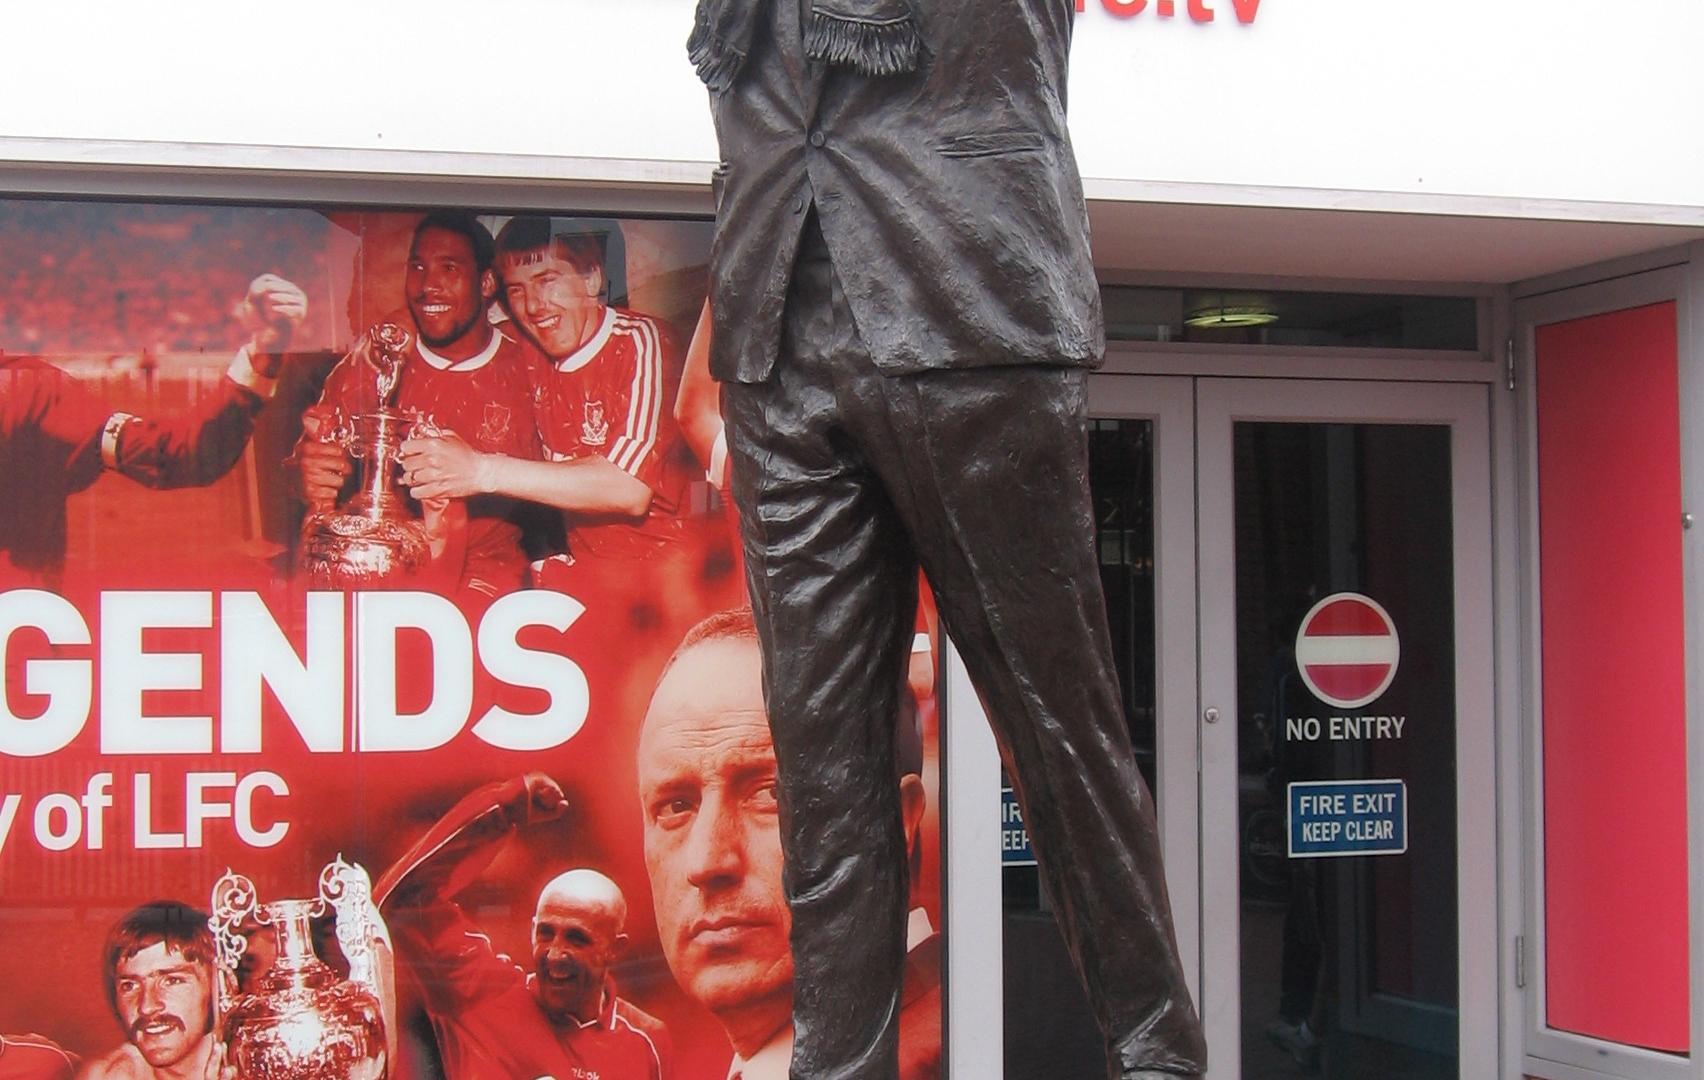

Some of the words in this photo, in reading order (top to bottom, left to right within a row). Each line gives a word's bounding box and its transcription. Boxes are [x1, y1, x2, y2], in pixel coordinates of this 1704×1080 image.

[0, 589, 590, 756] GENDS
[1286, 717, 1321, 740] NO
[1329, 716, 1406, 740] ENTRY
[34, 771, 113, 850] of
[134, 770, 290, 847] LFC
[1002, 802, 1023, 823] IR
[1300, 795, 1346, 815] FIRE
[1353, 793, 1396, 813] EXIT
[1303, 821, 1341, 841] KEEP
[1345, 820, 1393, 840] CLEAR
